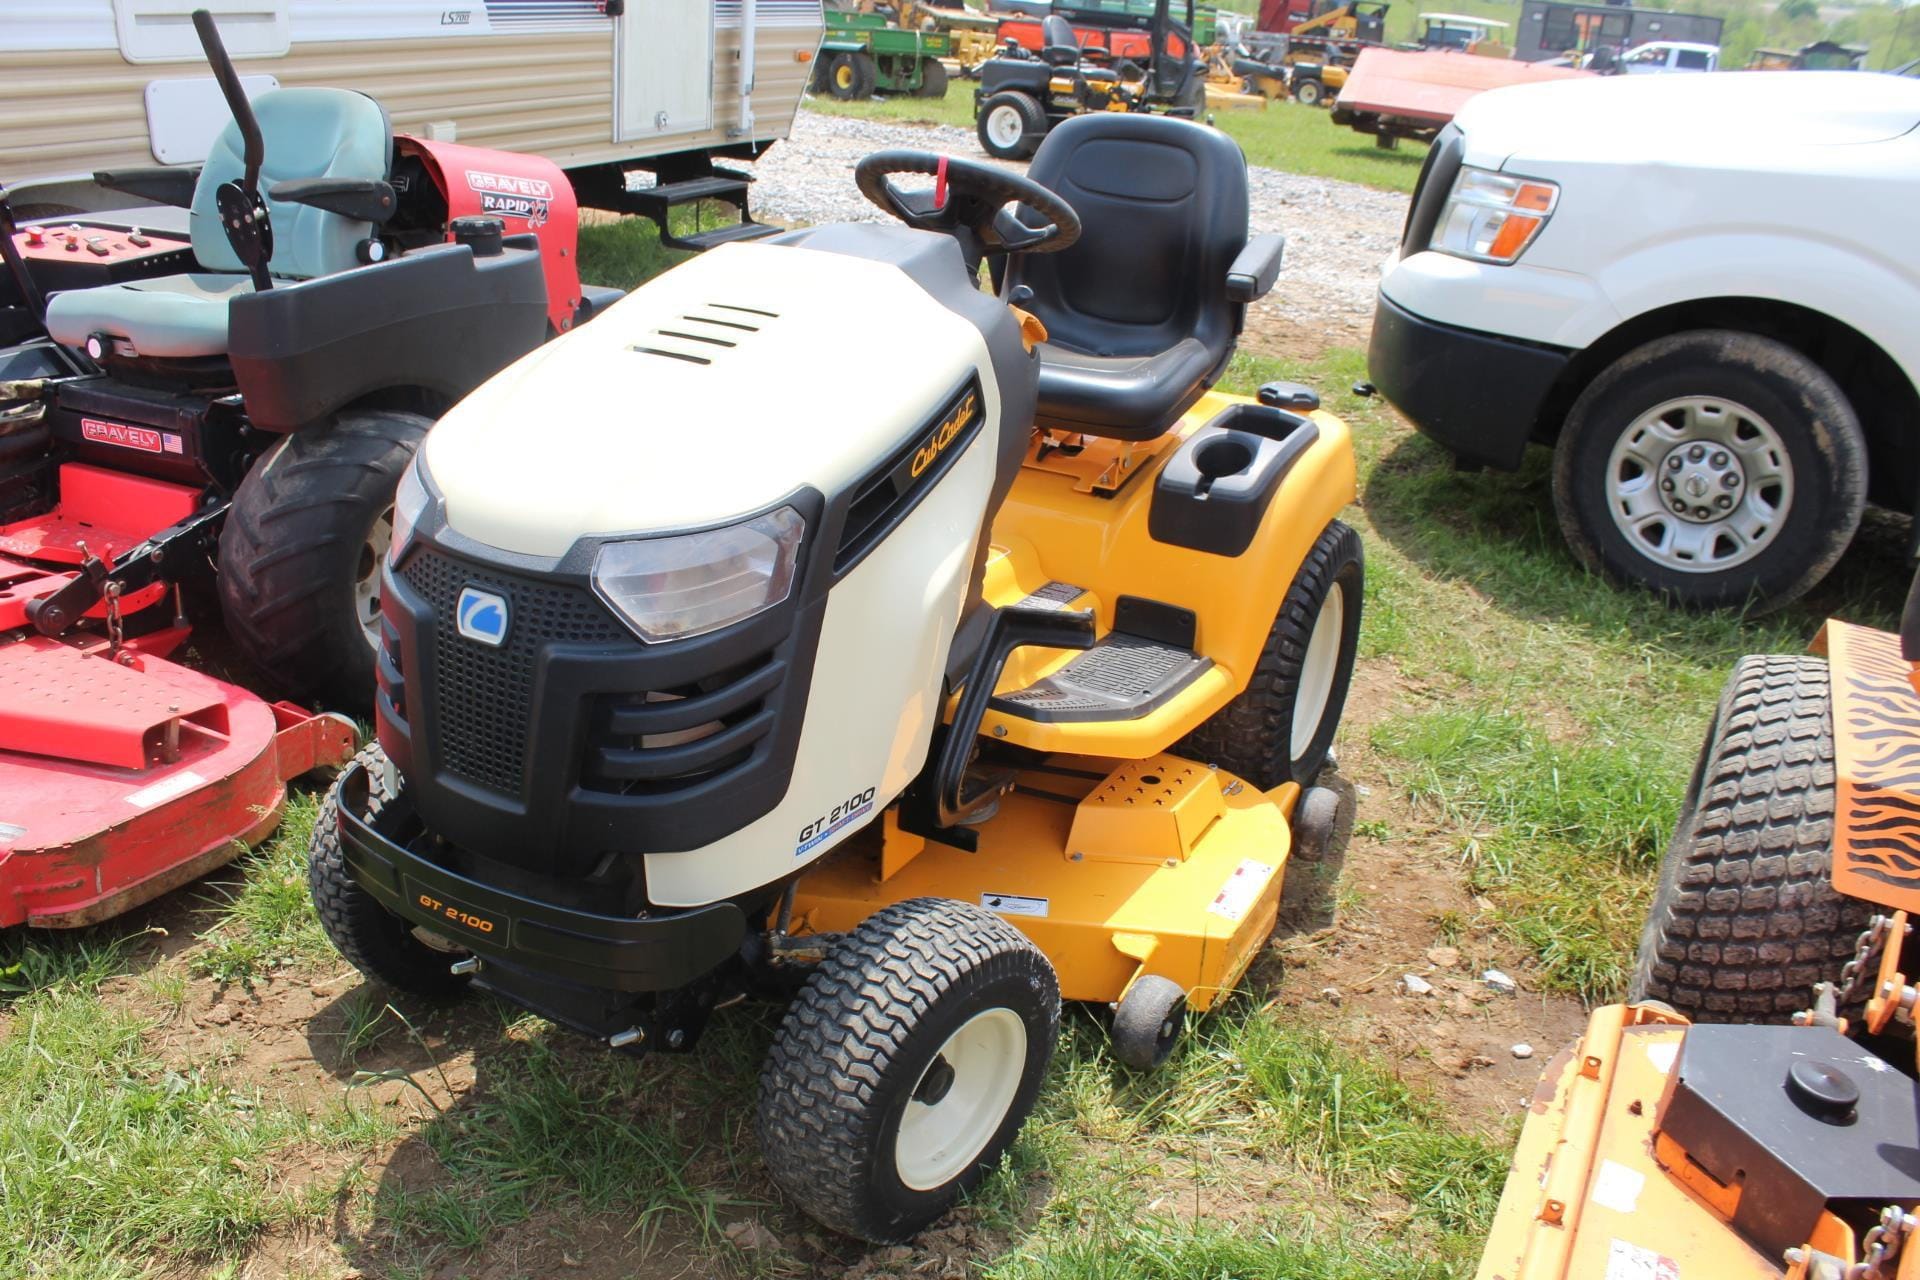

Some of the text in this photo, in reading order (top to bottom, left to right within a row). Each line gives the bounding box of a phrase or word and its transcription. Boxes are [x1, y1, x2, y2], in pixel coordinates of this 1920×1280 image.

[469, 173, 548, 197] GRAVELY
[484, 195, 529, 212] RAPID
[85, 422, 158, 445] GRAVELY
[911, 395, 975, 478] Cub Cadet
[799, 787, 876, 843] GT 2100
[419, 894, 494, 933] GT 2100
